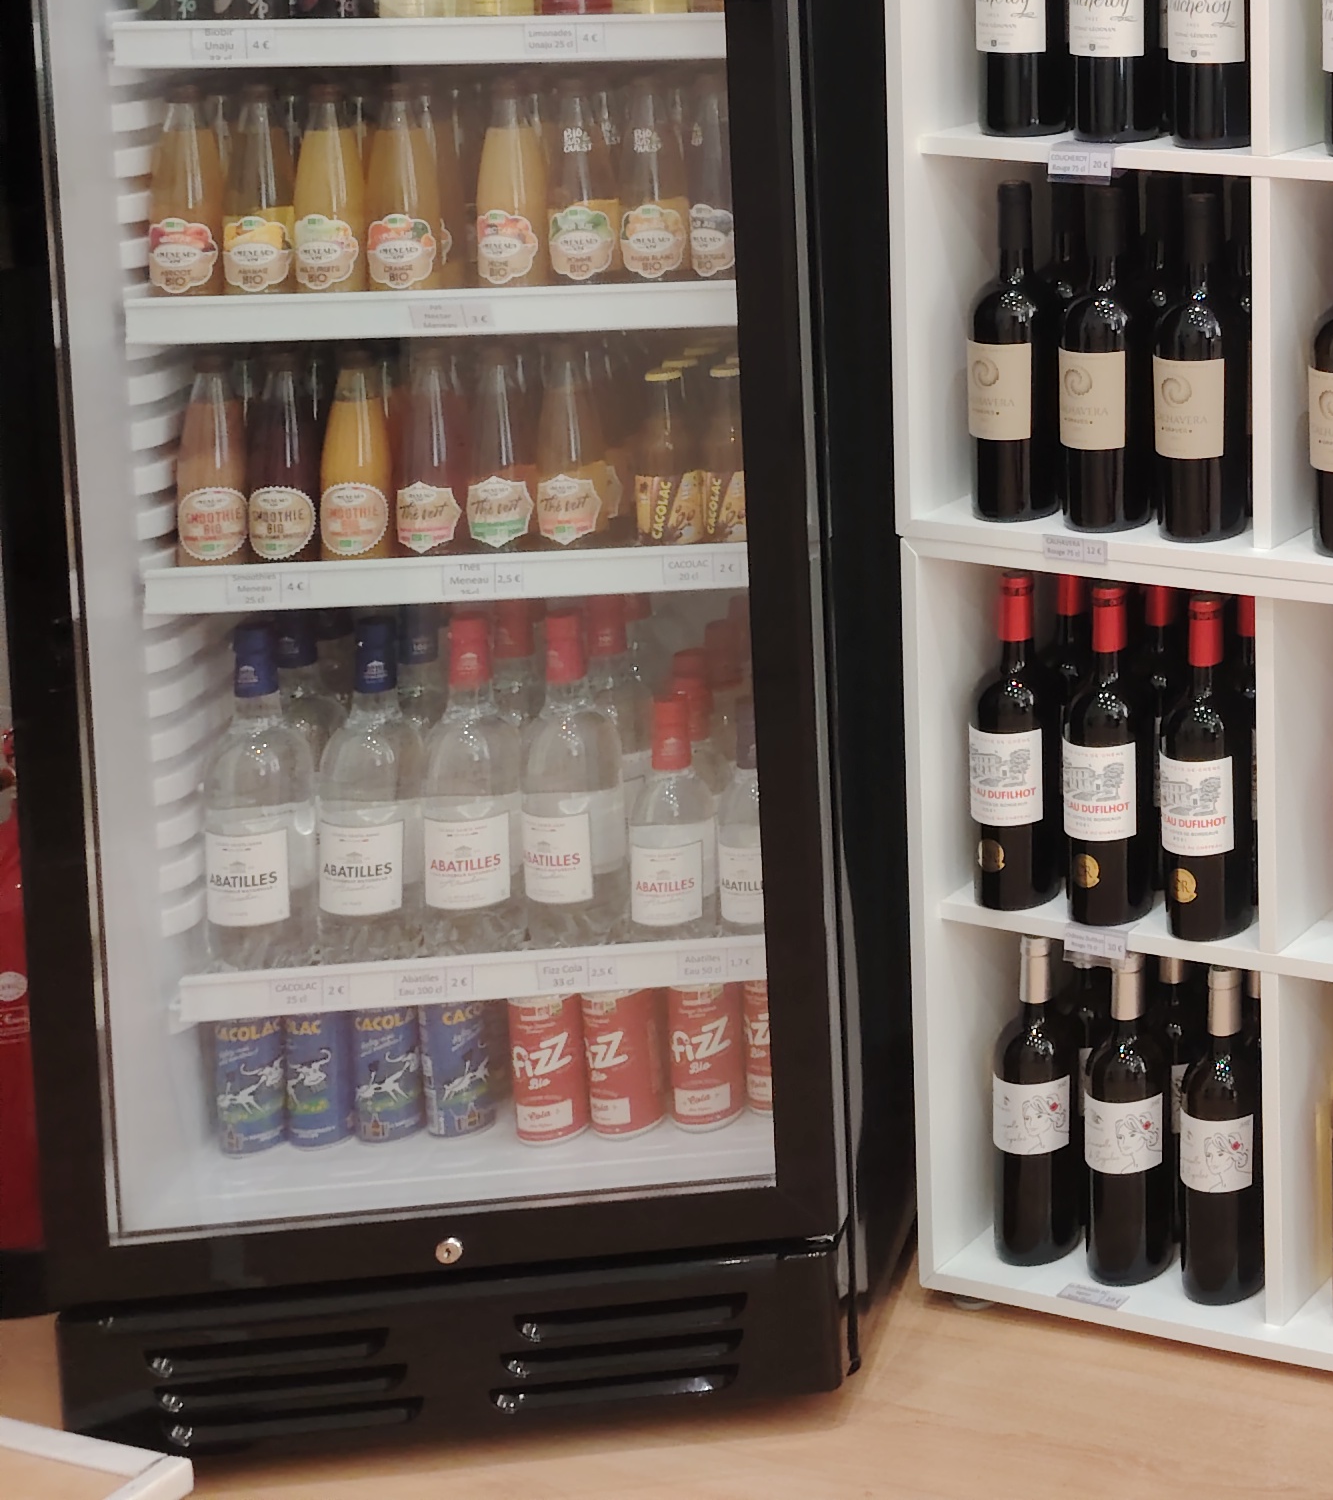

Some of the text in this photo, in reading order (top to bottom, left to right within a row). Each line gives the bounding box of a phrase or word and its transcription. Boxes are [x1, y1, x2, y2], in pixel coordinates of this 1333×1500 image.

[652, 482, 671, 540] CACOLAC
[988, 787, 1036, 800] DUFILHOT
[1082, 801, 1130, 813] DUFILHOT
[1179, 816, 1227, 828] DUFILHOT
[431, 854, 500, 872] ABATILLES
[324, 863, 392, 878] ABATILLES
